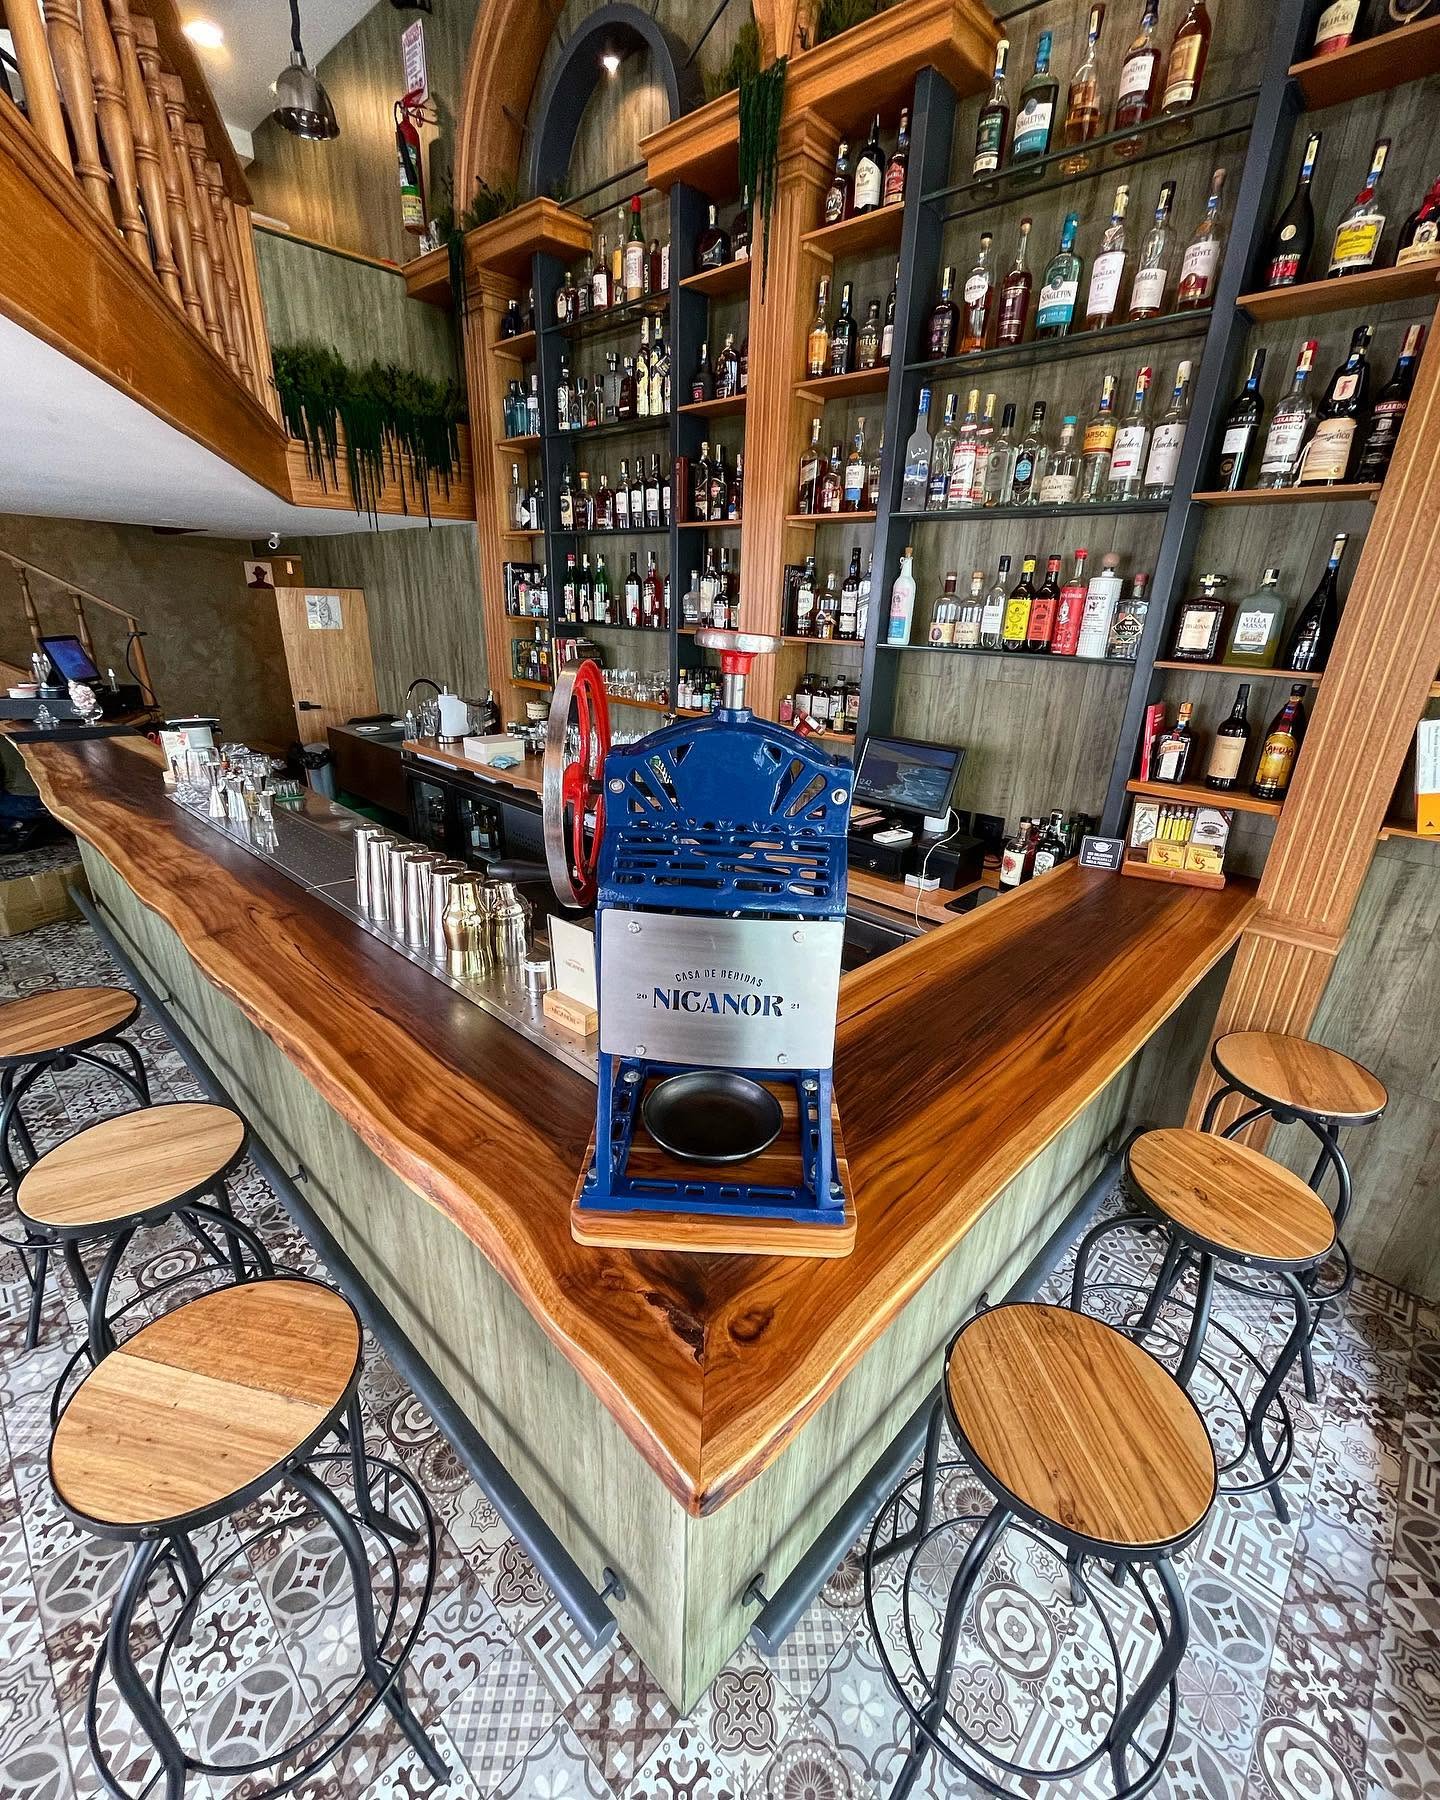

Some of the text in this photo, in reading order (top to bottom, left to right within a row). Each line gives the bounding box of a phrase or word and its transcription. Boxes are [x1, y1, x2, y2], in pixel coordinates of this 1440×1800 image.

[1242, 622, 1268, 630] MASSA
[1245, 616, 1267, 624] VILLA
[675, 969, 763, 987] CASA DE BEBIDAS
[636, 992, 648, 1000] 20
[653, 987, 784, 1017] NICANOR
